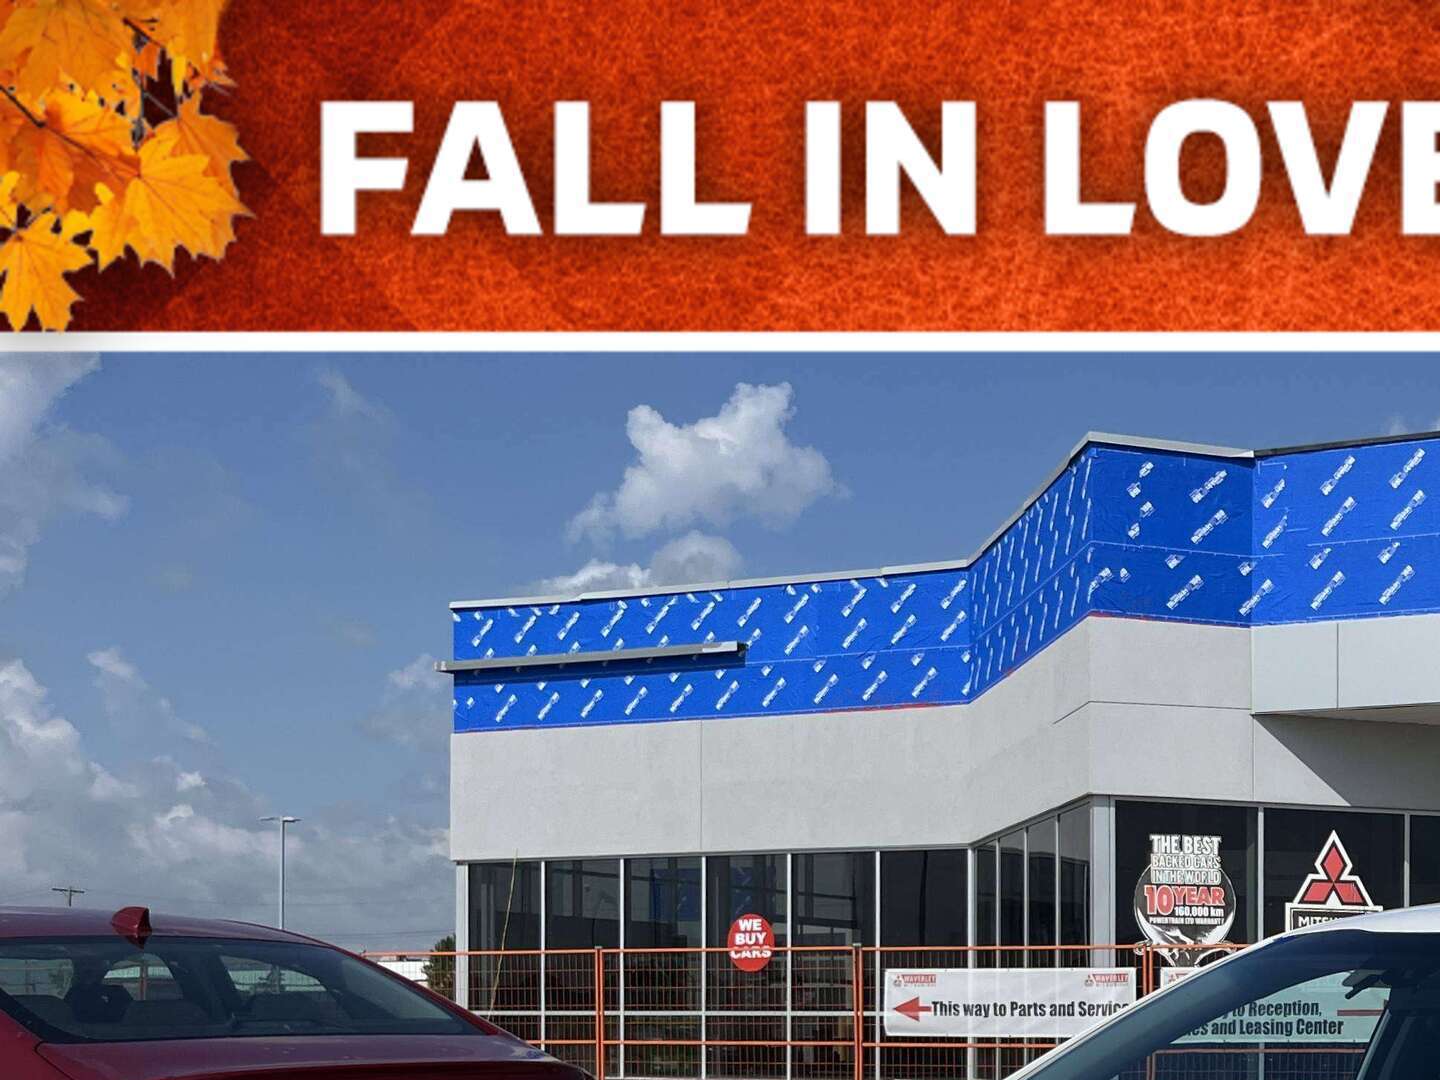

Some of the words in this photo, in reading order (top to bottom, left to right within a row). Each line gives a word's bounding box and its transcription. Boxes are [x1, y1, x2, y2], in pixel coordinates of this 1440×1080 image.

[1150, 835, 1180, 854] THE
[1182, 836, 1221, 855] BEST
[1152, 855, 1192, 869] BACKED
[1194, 856, 1220, 869] CARS
[1162, 870, 1182, 884] THE
[1184, 871, 1221, 884] WORLD
[1144, 885, 1174, 915] 10
[1172, 886, 1225, 906] YEAR
[1210, 906, 1224, 917] km
[739, 919, 762, 931] WE
[735, 932, 767, 945] BUY
[730, 946, 772, 959] CARS
[931, 1001, 960, 1016] This
[963, 1003, 990, 1018] way
[994, 1002, 1006, 1017] to
[1011, 1001, 1044, 1017] Parts
[1049, 1001, 1075, 1017] and
[1250, 1000, 1322, 1018] Reception,
[1211, 1020, 1237, 1036] and
[1239, 1019, 1293, 1037] Leasing
[1296, 1018, 1344, 1035] Center
